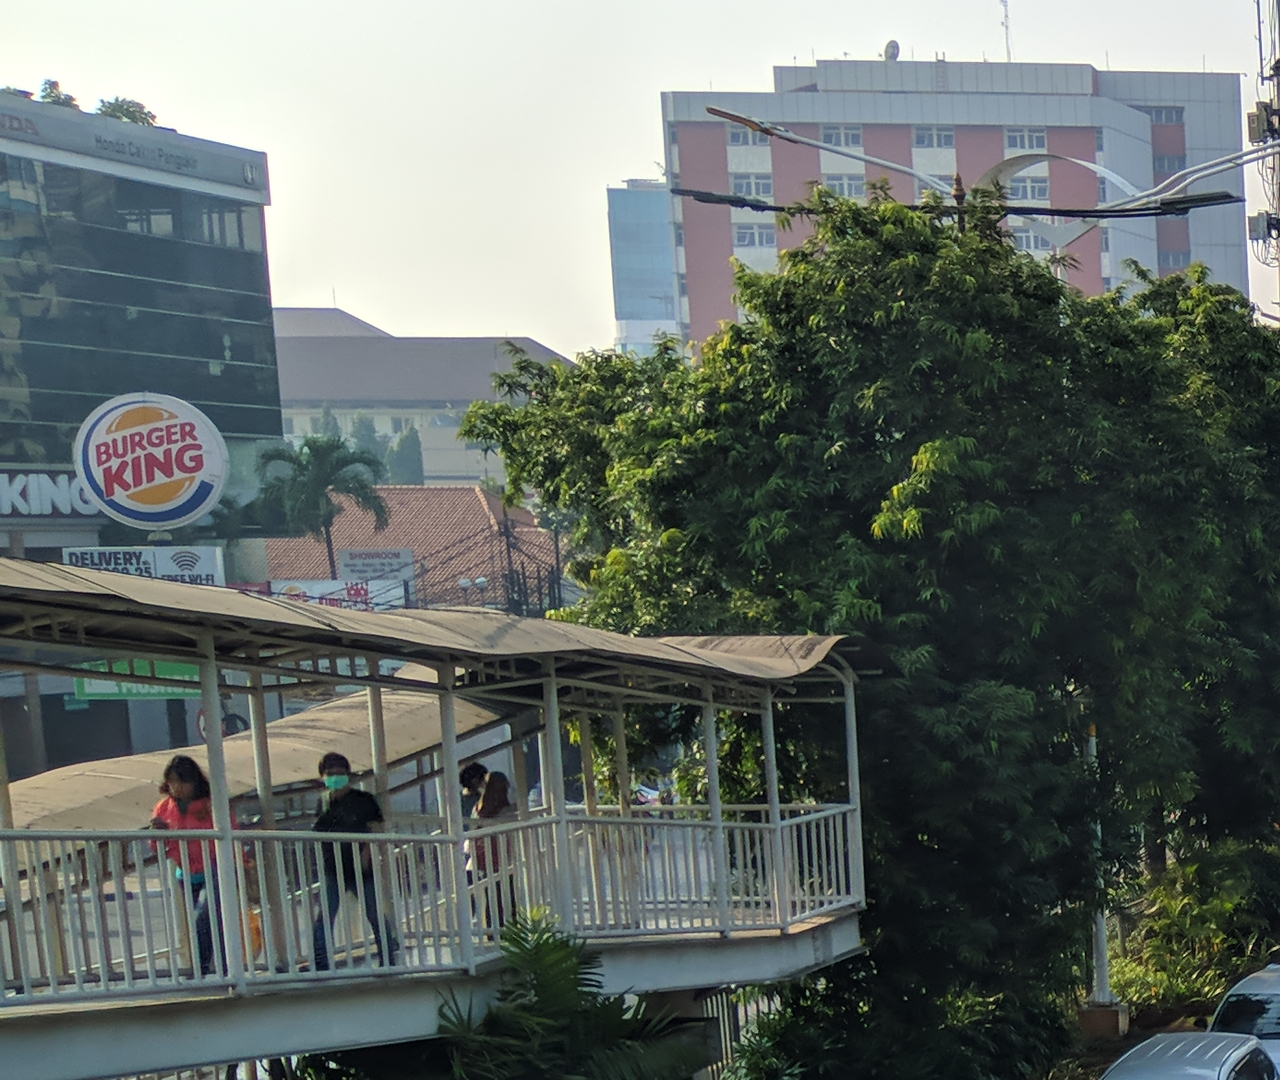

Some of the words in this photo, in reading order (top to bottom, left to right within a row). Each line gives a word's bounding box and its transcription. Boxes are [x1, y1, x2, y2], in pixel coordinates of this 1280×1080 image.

[95, 422, 198, 467] BURGER
[103, 443, 204, 497] KING
[69, 551, 142, 567] DELIVERY
[349, 552, 401, 560] SHOWROOM
